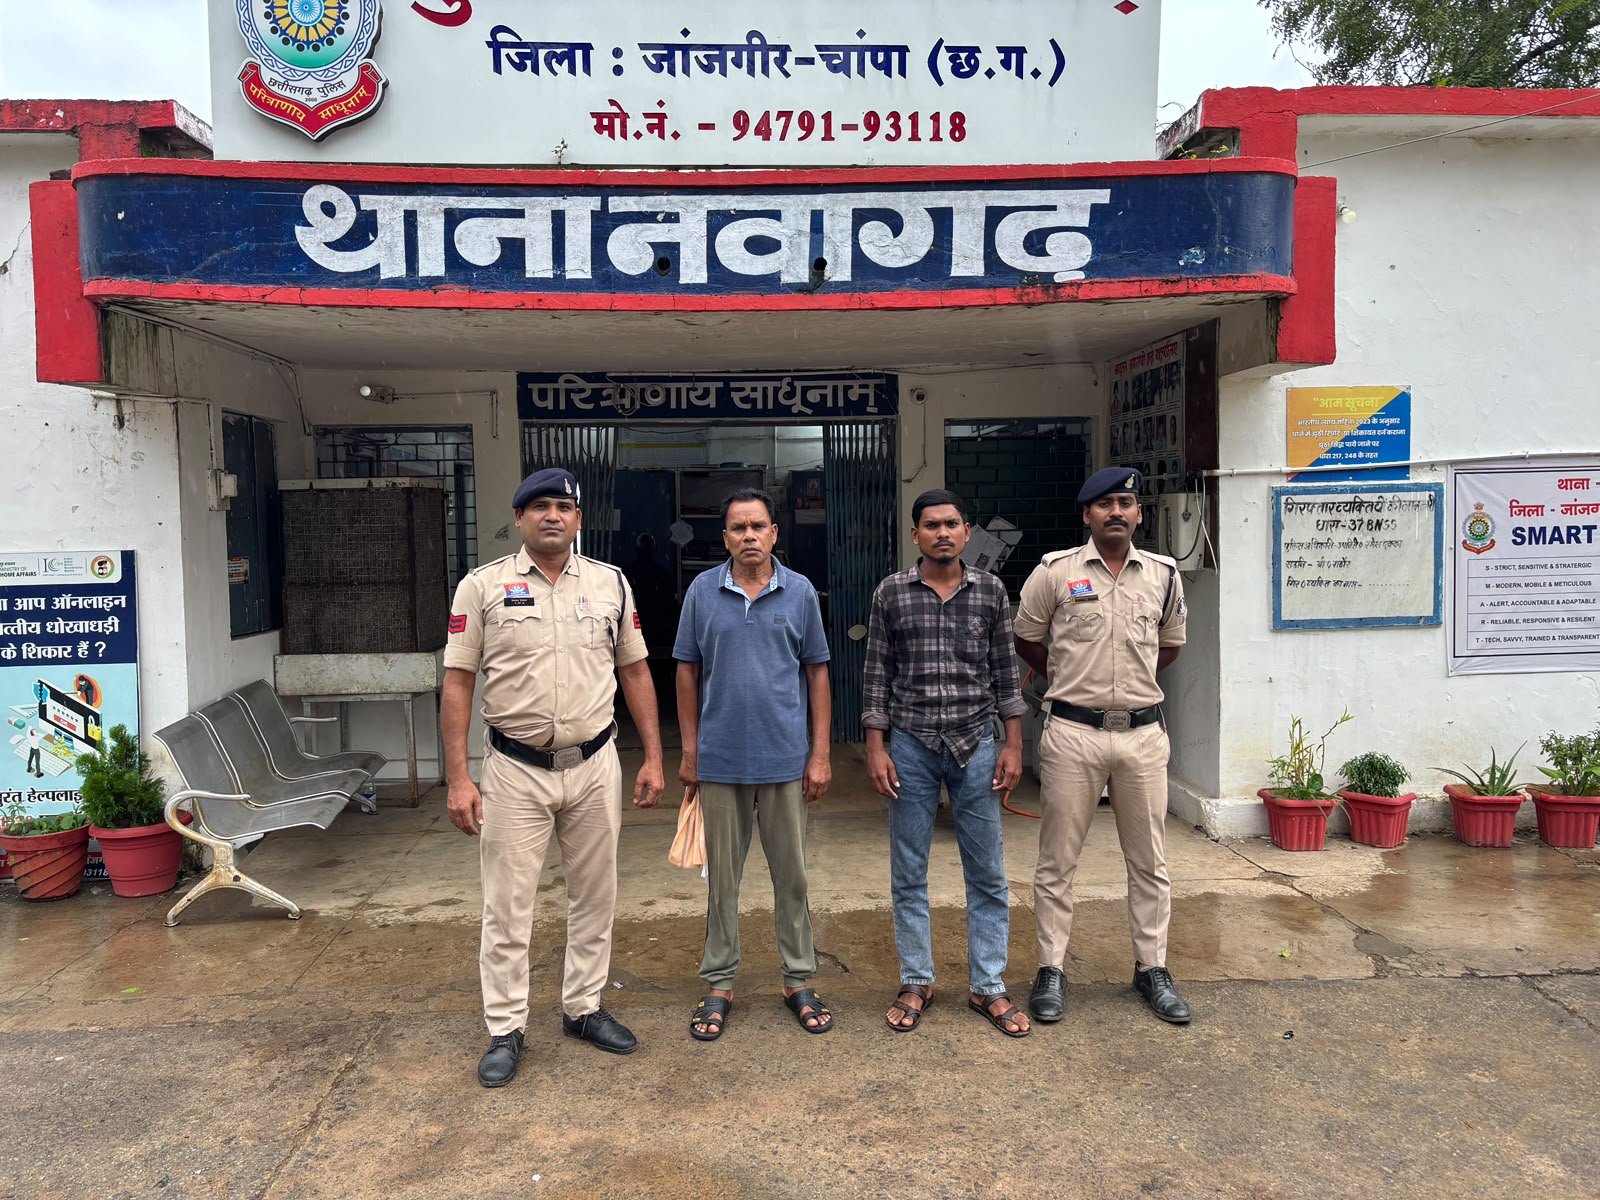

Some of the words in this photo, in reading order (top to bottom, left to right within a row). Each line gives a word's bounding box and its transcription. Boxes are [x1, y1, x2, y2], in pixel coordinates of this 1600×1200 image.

[486, 25, 594, 77] जिला
[638, 27, 911, 79] जांजगीर-चांपा
[927, 37, 1066, 87] (छ.ग.)
[267, 76, 313, 97] छत्तीसगढ़
[317, 79, 347, 98] पुलिस
[249, 82, 306, 122] परित्राणाय
[732, 110, 967, 142] 94791-93118
[528, 374, 725, 412] परित्राणाय
[1557, 478, 1591, 491] थाना
[1509, 499, 1546, 518] जिला
[1511, 524, 1598, 547] SMART
[13, 597, 46, 611] आप
[51, 593, 127, 612] ऑनलाइन
[0, 617, 41, 635] त्तीय
[45, 616, 120, 635] धोखाधड़ी
[1557, 633, 1600, 641] TRANSPARENT
[0, 642, 17, 660] के
[21, 642, 73, 660] शिकार
[76, 640, 90, 658] हैं
[94, 641, 107, 658] ?
[27, 787, 83, 804] हेल्पलाइ
[83, 868, 109, 877] 3118
